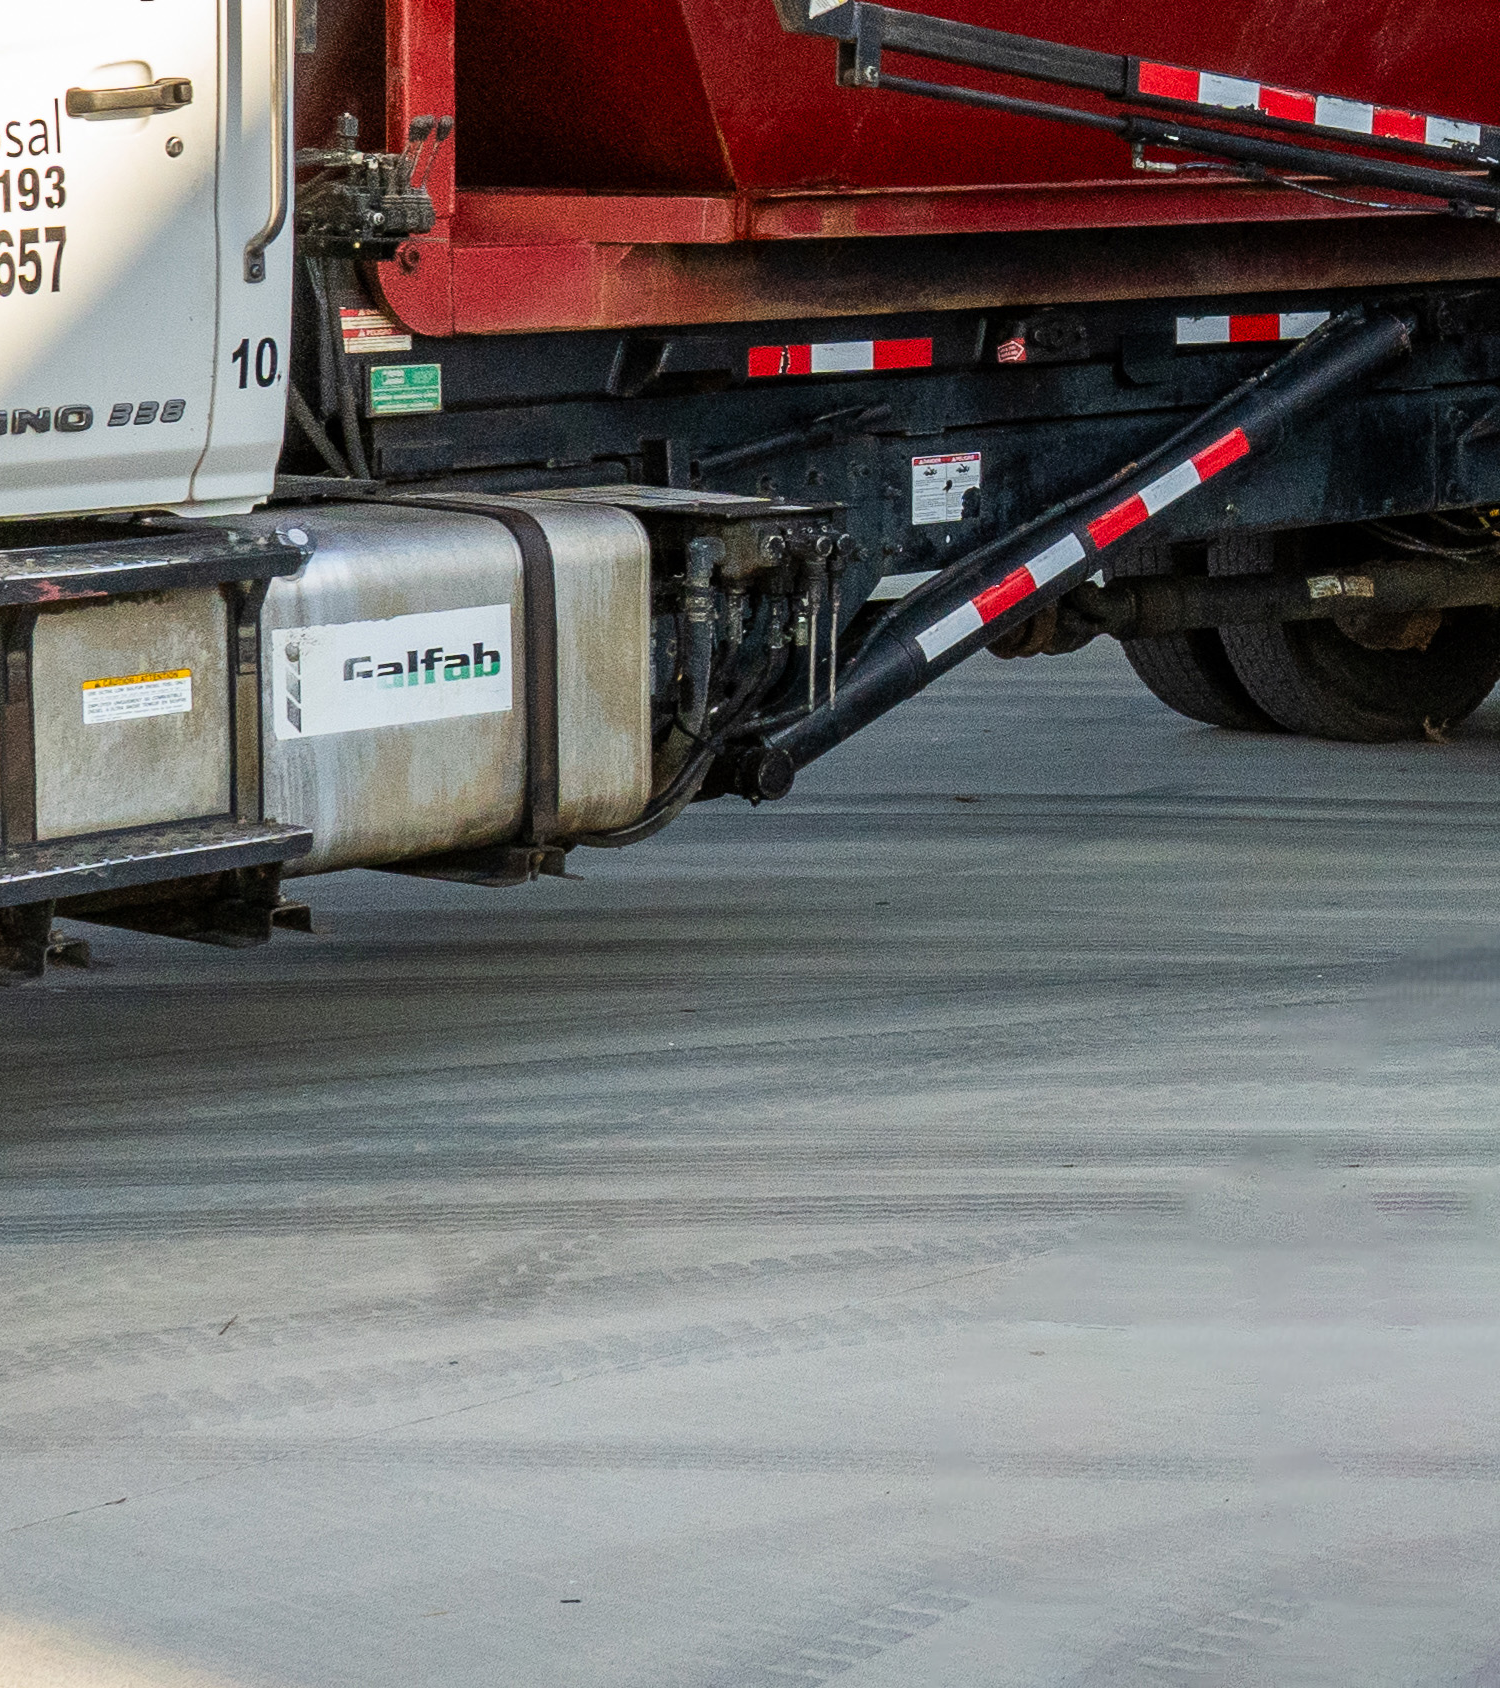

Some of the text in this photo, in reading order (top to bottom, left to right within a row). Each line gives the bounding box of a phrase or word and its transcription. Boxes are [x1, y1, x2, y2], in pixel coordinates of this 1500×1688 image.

[231, 337, 279, 389] 10
[106, 398, 187, 427] 338
[343, 642, 501, 690] Galfab
